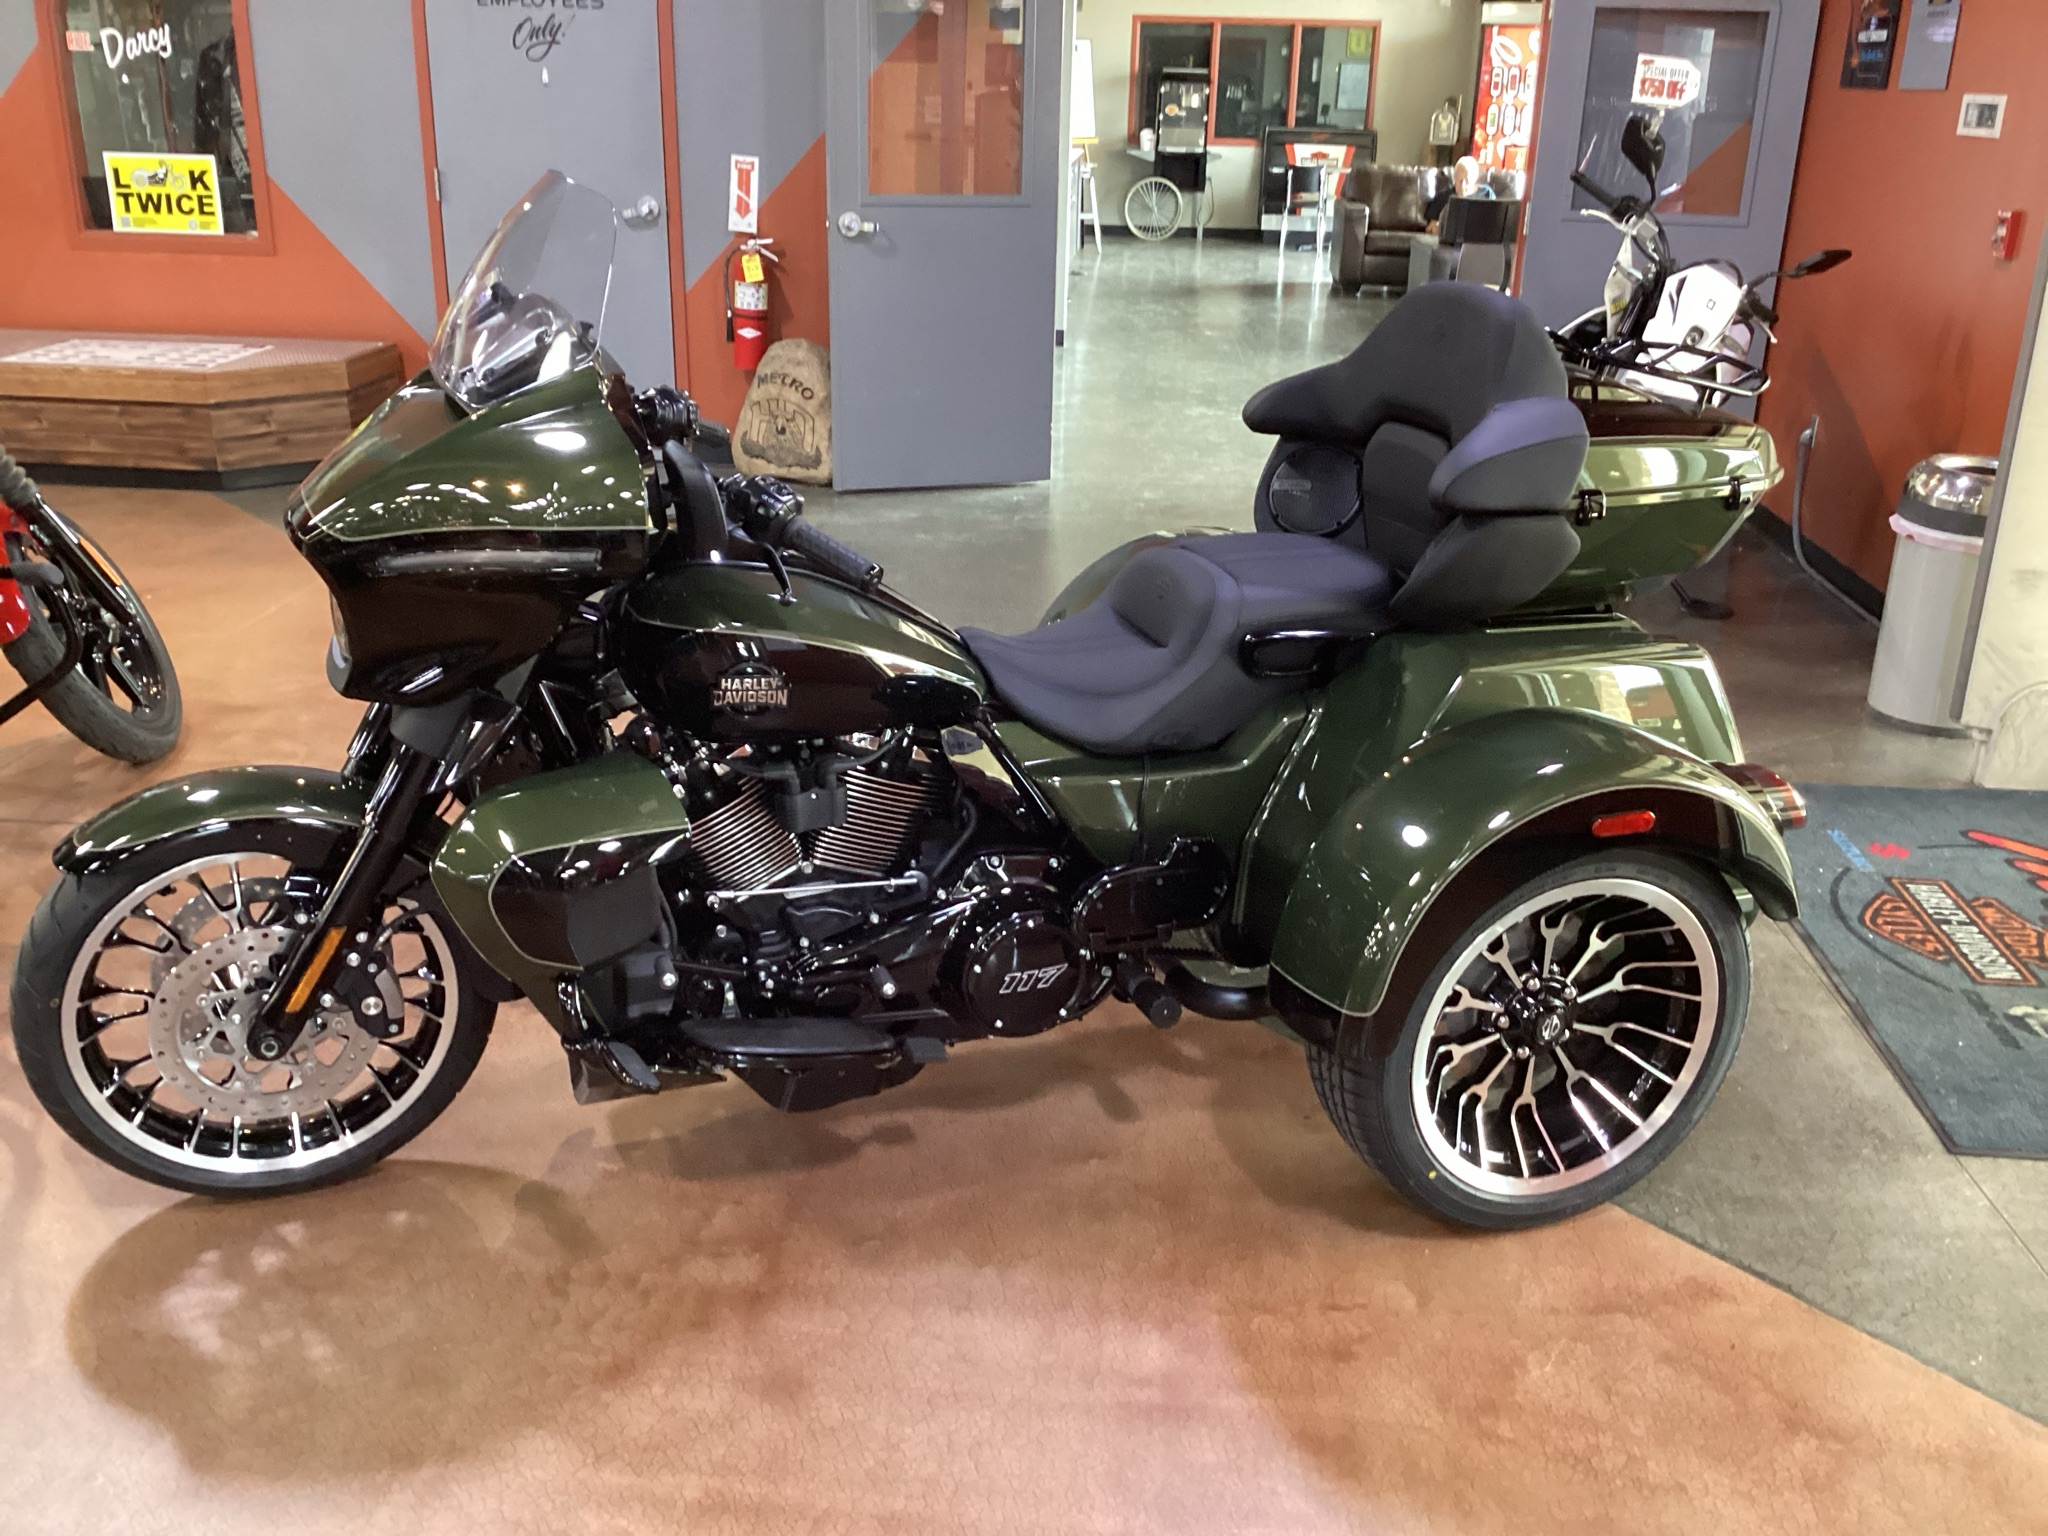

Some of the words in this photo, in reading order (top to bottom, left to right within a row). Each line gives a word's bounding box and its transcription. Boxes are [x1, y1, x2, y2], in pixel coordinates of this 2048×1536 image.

[100, 23, 172, 68] Darcy
[513, 13, 575, 62] Only!
[116, 192, 216, 217] TWICE
[757, 371, 815, 400] METRO
[713, 689, 788, 706] DAVIDSON
[999, 962, 1068, 993] 117
